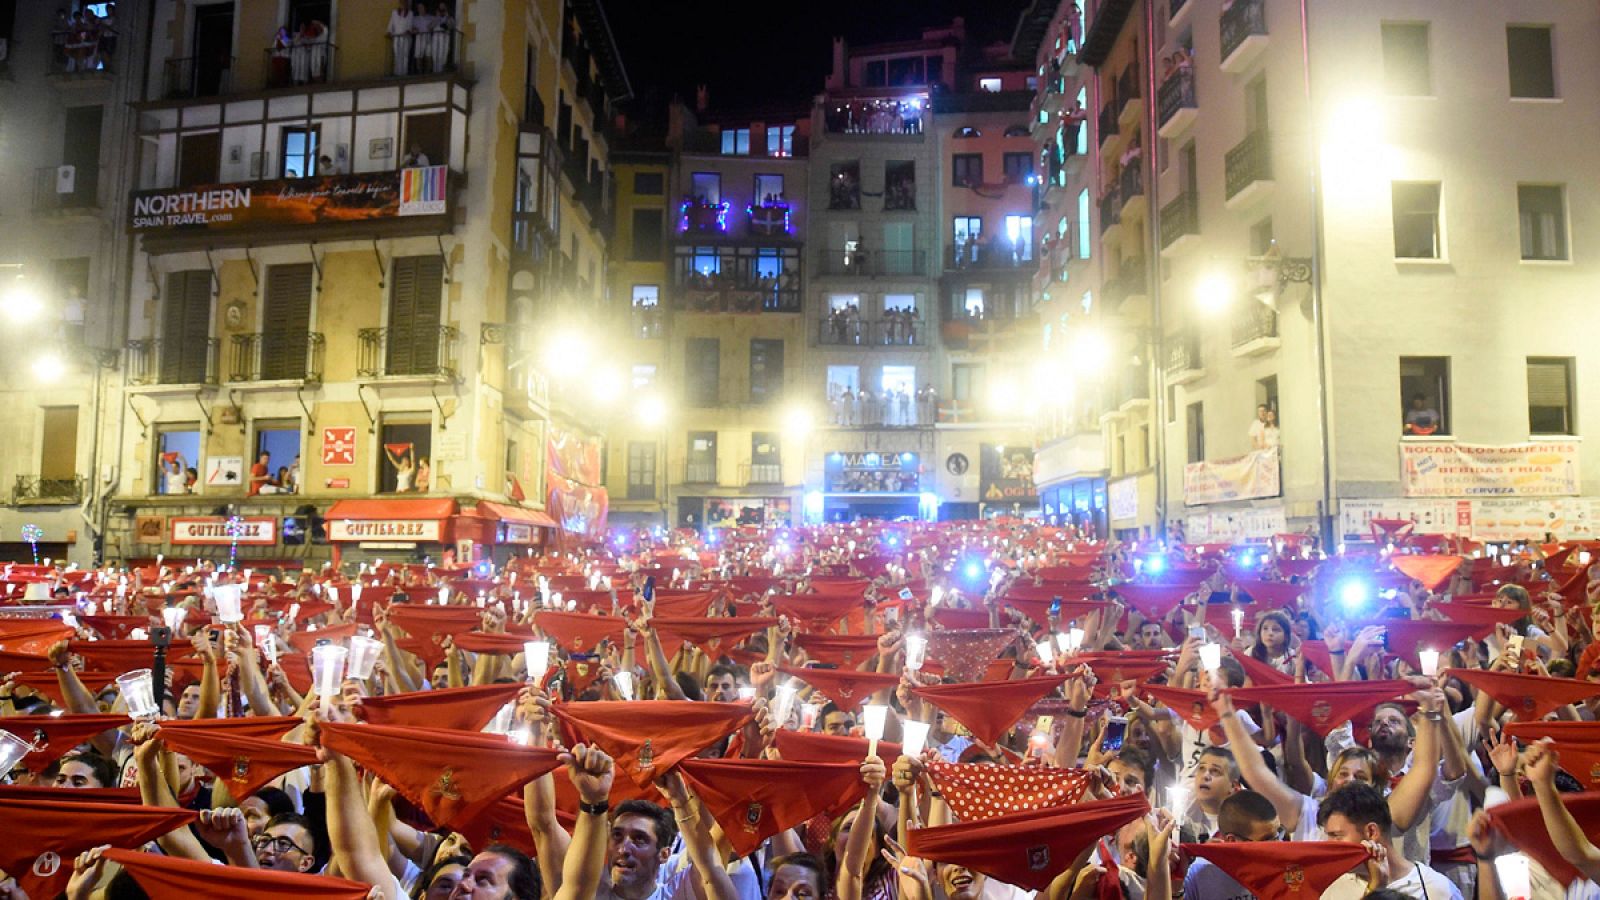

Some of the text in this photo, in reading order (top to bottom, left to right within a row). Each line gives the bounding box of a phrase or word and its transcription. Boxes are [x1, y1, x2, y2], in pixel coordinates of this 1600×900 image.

[134, 187, 251, 216] NORTHERN
[133, 215, 165, 229] SPAIN
[1499, 445, 1575, 455] CALIENTES
[1509, 465, 1553, 473] FRIAS
[1465, 487, 1515, 495] CERVEZA
[346, 523, 424, 536] GUTIERREZ
